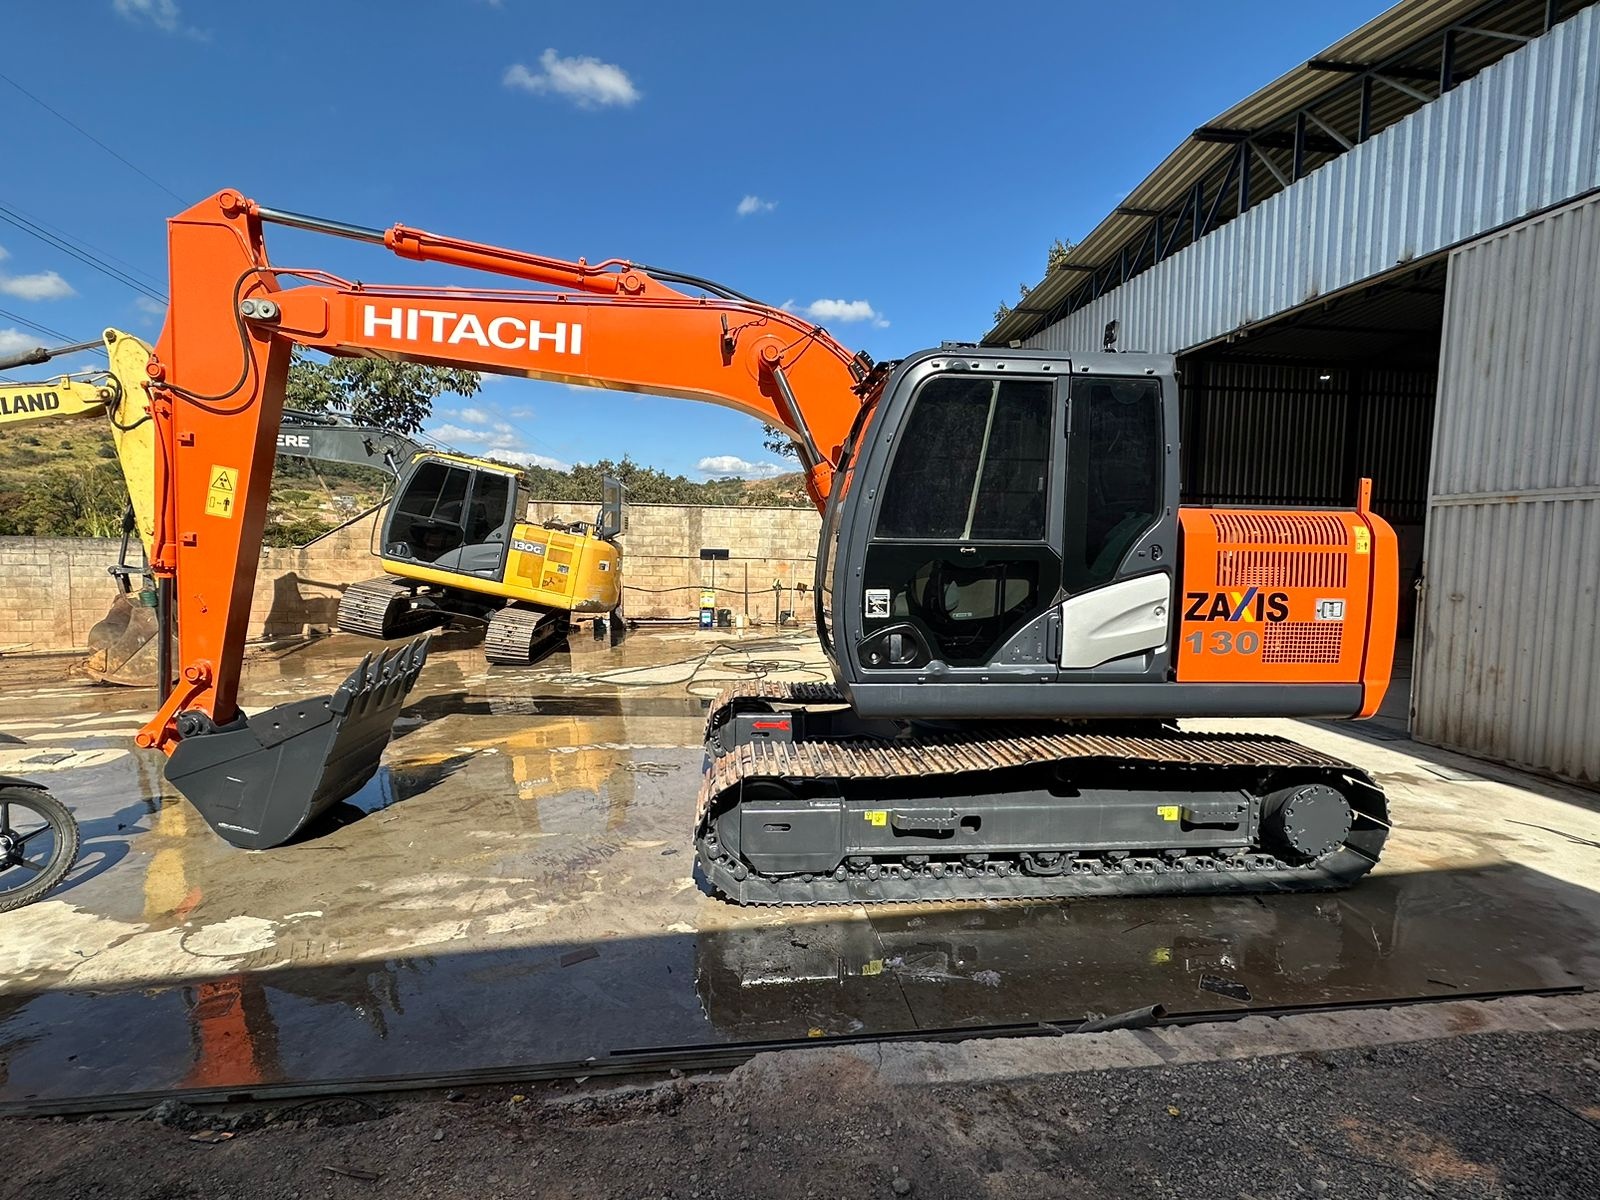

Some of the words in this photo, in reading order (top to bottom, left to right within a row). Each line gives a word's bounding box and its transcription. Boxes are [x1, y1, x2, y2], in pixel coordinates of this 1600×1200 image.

[364, 305, 582, 355] HITACHI
[0, 392, 59, 415] LAND
[514, 541, 541, 554] 130G
[1184, 587, 1289, 622] ZAXIS
[1185, 631, 1259, 654] 130
